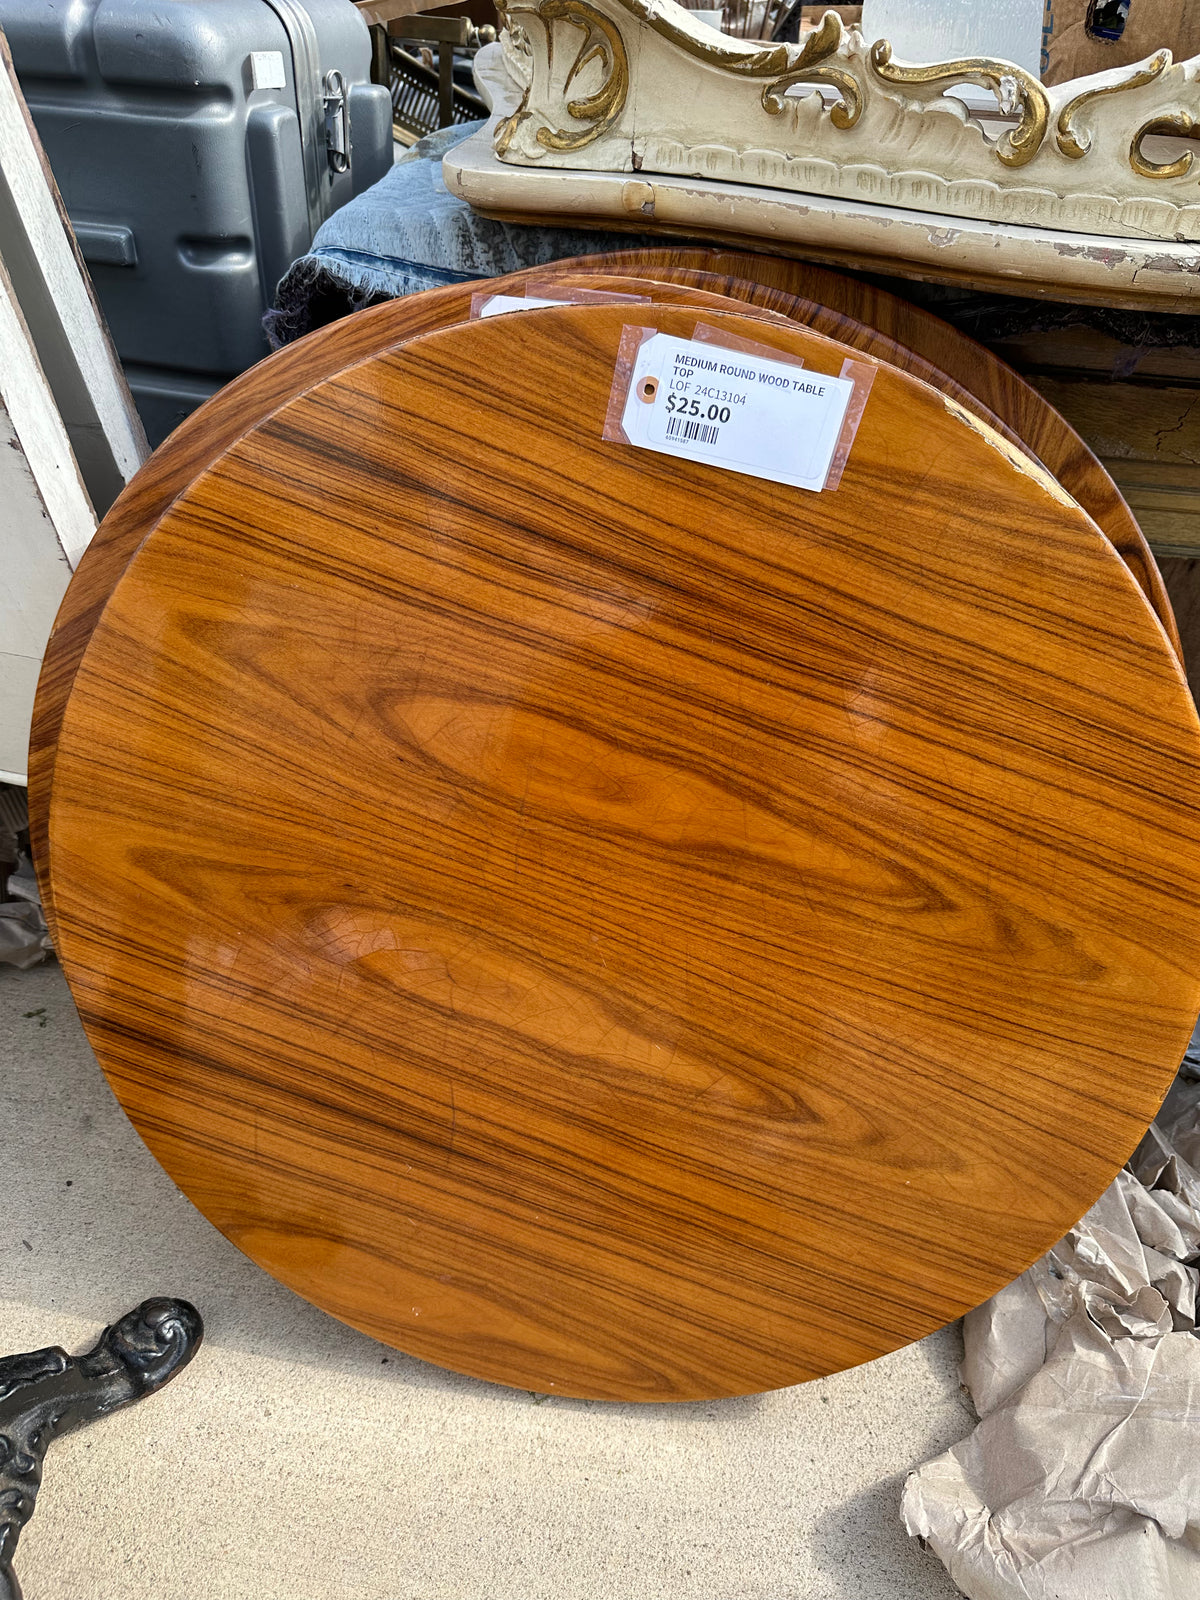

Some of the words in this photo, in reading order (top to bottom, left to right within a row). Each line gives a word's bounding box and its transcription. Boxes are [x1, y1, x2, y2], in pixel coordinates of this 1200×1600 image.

[673, 366, 694, 379] TOP
[675, 354, 718, 372] MEDIUM
[719, 364, 756, 381] ROUND
[758, 373, 790, 389] WOOD
[792, 381, 826, 397] TABLE
[669, 378, 691, 393] LOF
[694, 385, 747, 406] 24C13104
[665, 392, 731, 424] $25.00
